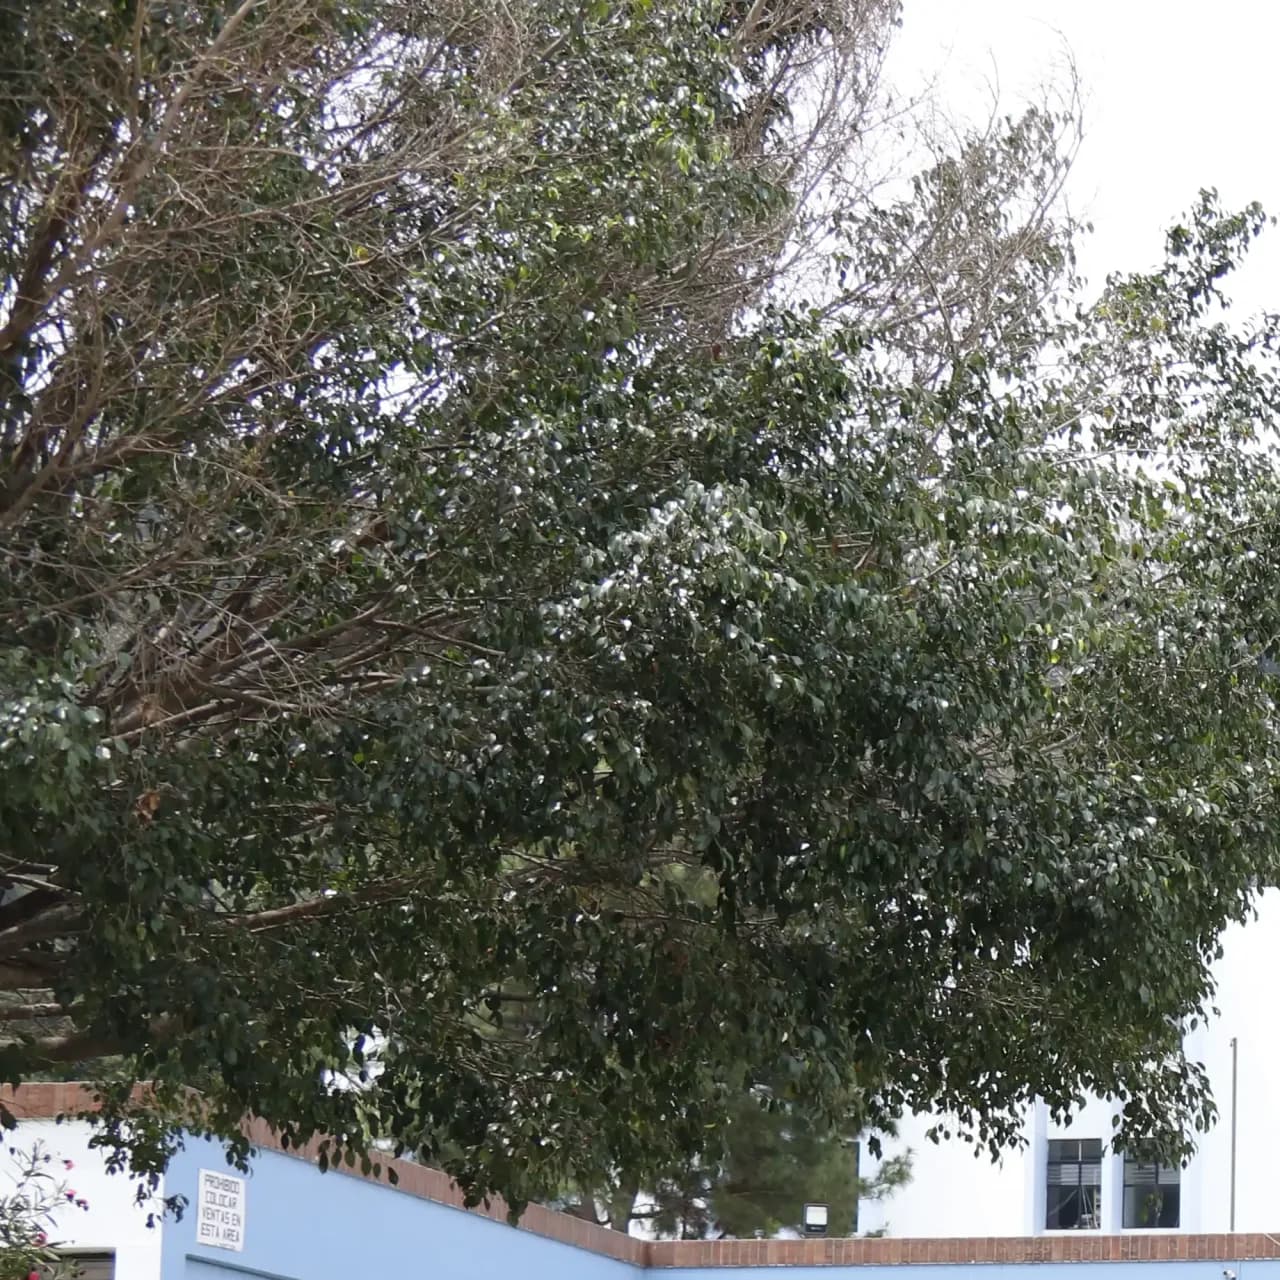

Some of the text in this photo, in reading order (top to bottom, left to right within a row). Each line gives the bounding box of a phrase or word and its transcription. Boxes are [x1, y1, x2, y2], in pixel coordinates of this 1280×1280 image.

[205, 1190, 237, 1209] COLOCAR
[202, 1207, 241, 1227] VENTAS EN
[200, 1222, 220, 1238] ESTA
